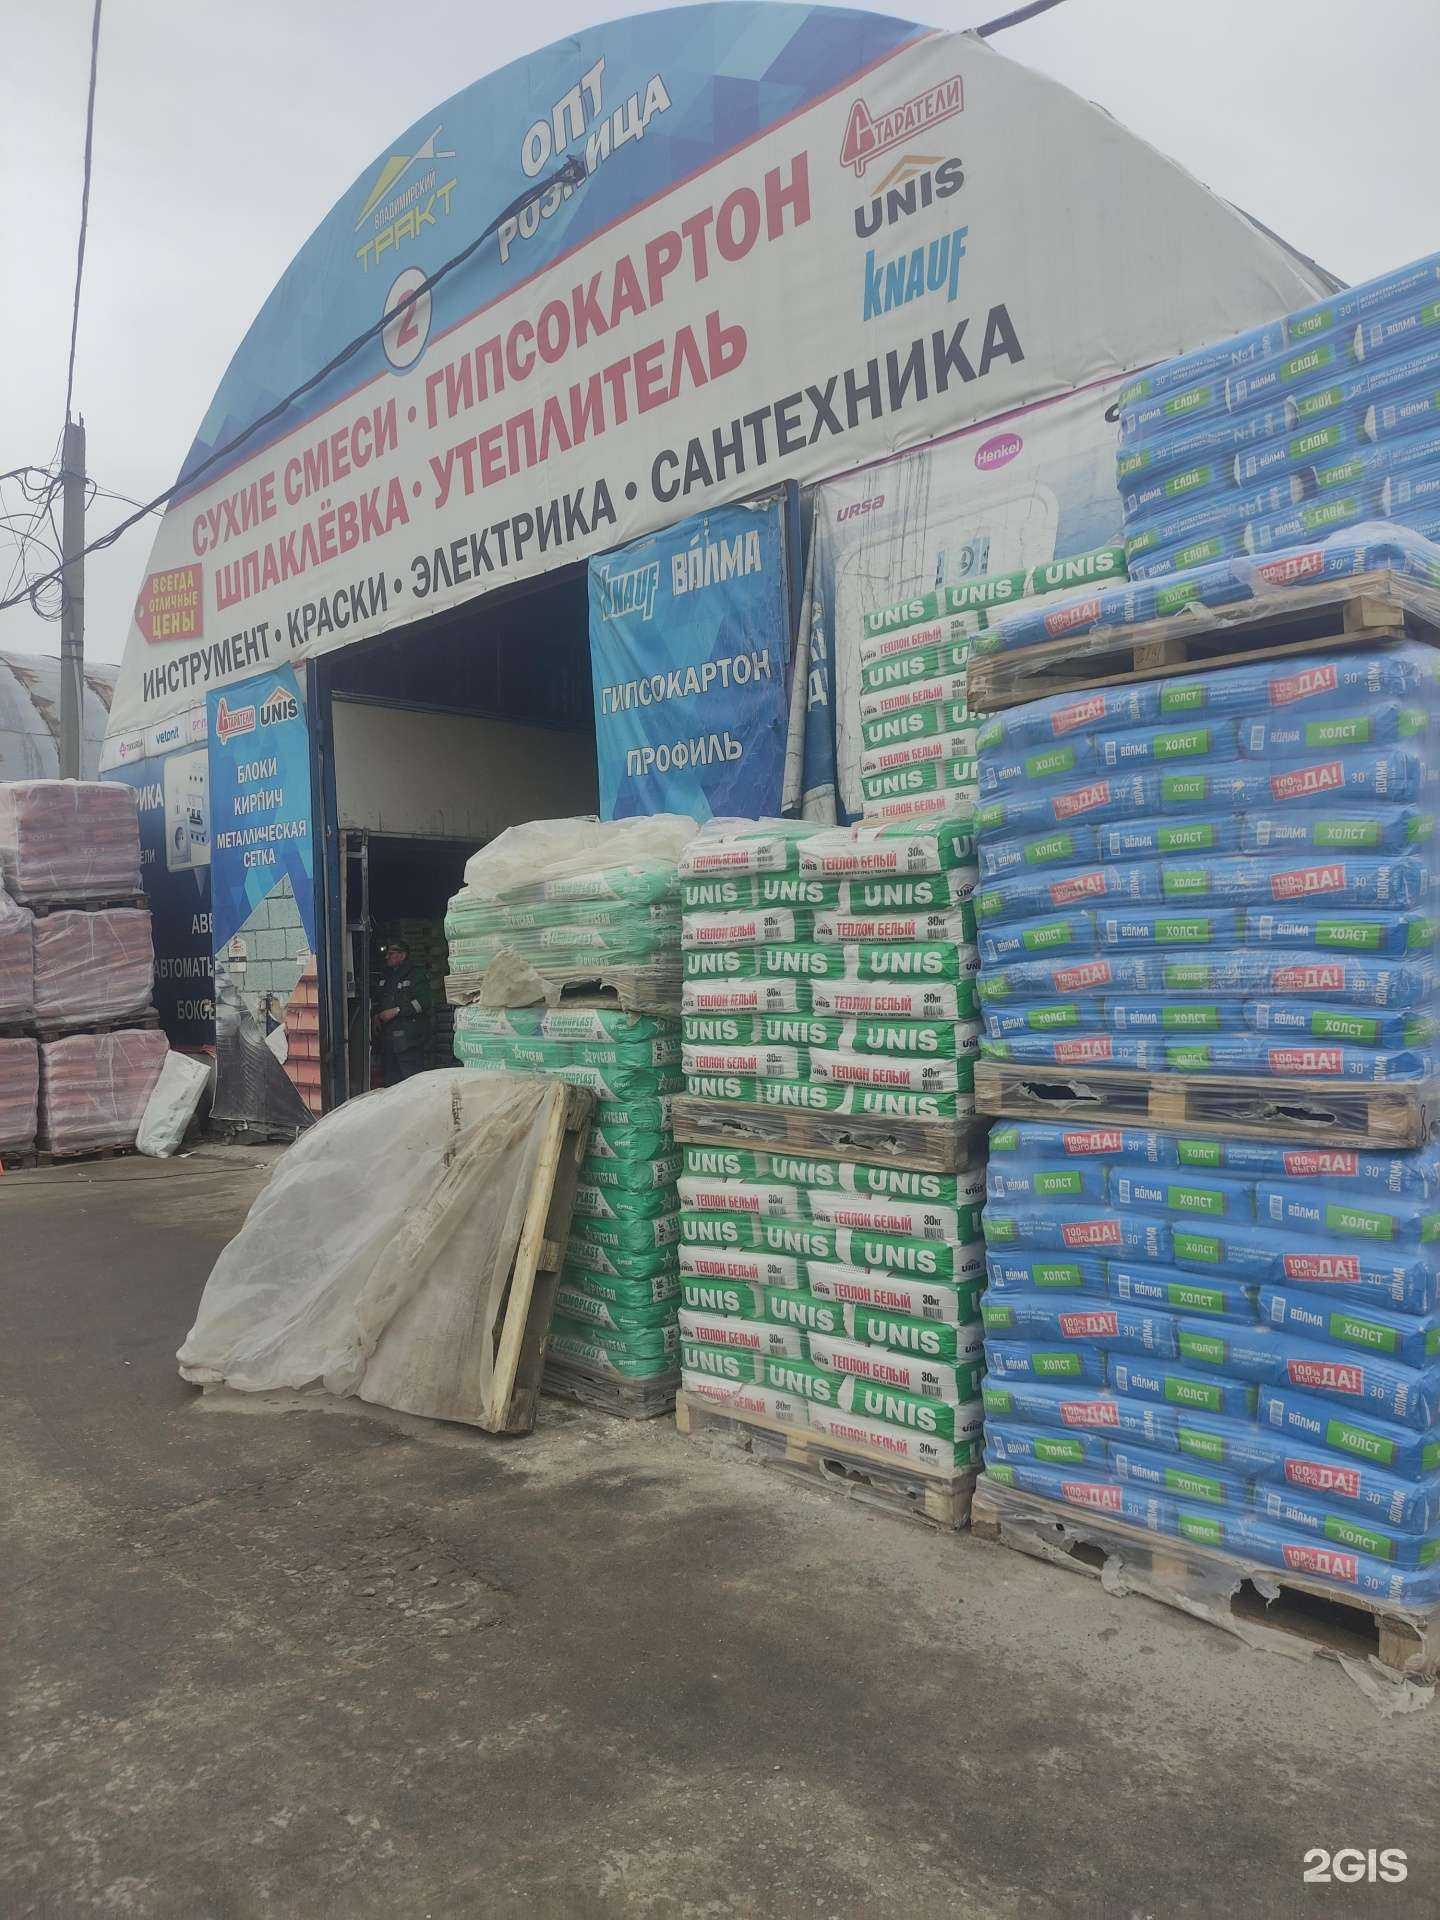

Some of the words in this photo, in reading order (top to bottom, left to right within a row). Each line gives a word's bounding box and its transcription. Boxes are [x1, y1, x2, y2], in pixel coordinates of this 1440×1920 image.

[521, 56, 606, 178] ОПТ
[497, 73, 672, 264] РОЗИЦА
[373, 166, 438, 231] ВЛАДИМИРСКИЙ
[854, 157, 965, 239] UNIS
[356, 178, 457, 273] ТРАКТ
[396, 288, 420, 349] 2
[192, 471, 277, 557] СУХИЕ
[283, 398, 398, 506] СМЕСИ
[425, 150, 812, 430] ГИПСОКАРТОН
[215, 476, 410, 612] ШПАКЛЁВКА
[429, 310, 748, 509] УТЕПЛИТЕЛЬ
[976, 437, 1021, 467] Henkel
[143, 622, 270, 703] ИНСТРУМЕНТ
[287, 571, 388, 649] КРАСКИ
[410, 478, 618, 598] ЭЛЕКТРИКА
[651, 304, 1026, 502] САНТЕХНИКА
[1045, 551, 1114, 585] UNIS
[152, 571, 195, 594] ВСЕГДА
[952, 578, 1012, 607] UNIS
[149, 591, 199, 612] ОТЛИЧНЫЕ
[869, 600, 924, 631] UNIS
[152, 611, 196, 640] ЦЕНЫ
[601, 649, 771, 715] ГИПСОКАРТОН
[868, 656, 926, 687] UNIS
[260, 698, 298, 726] UNIS
[868, 713, 924, 743] UNIS
[627, 732, 743, 777] ПРОФИЛЬ
[236, 757, 278, 784] БЛОКИ
[868, 769, 924, 798] UNIS
[234, 788, 283, 816] КИРПИЧ
[216, 820, 307, 849] МЕТАЛЛИЧЕСКАЯ
[243, 847, 276, 868] СЕТКА
[686, 882, 738, 906] UNIS
[764, 880, 824, 903] UNIS
[864, 882, 934, 908] UNIS
[836, 922, 875, 937] ТЕПЛОН
[877, 919, 916, 936] БЕЛЫЙ
[687, 951, 740, 975] UNIS
[766, 951, 828, 974] UNIS
[870, 951, 944, 974] UNIS
[834, 995, 873, 1011] ТЕПЛОН
[875, 993, 913, 1012] БЕЛЫЙ
[685, 1020, 739, 1041] UNIS
[766, 1020, 827, 1045] UNIS
[866, 1025, 938, 1052] UNIS
[687, 1076, 742, 1098] UNIS
[831, 1064, 870, 1081] ТЕПЛОН
[872, 1065, 911, 1085] БЕЛЫЙ
[765, 1083, 828, 1108] UNIS
[863, 1093, 939, 1119] UNIS
[688, 1152, 741, 1175] UNIS
[772, 1158, 834, 1186] UNIS
[868, 1169, 941, 1197] UNIS
[729, 1193, 759, 1211] БЕЛЫЙ
[683, 1221, 738, 1242] UNIS
[833, 1211, 871, 1228] ТЕПЛОН
[873, 1212, 913, 1231] БЕЛЫЙ
[1340, 1214, 1380, 1231] ХОЛСТ
[767, 1226, 829, 1258] UNIS
[694, 1260, 726, 1276] ТЕПЛОН
[728, 1261, 758, 1279] БЕЛЫЙ
[864, 1242, 936, 1274] UNIS
[684, 1287, 740, 1312] UNIS
[833, 1282, 871, 1302] ТЕПЛОН
[873, 1289, 912, 1309] БЕЛЫЙ
[771, 1297, 834, 1332] UNIS
[696, 1326, 727, 1343] ТЕПЛОН
[728, 1330, 761, 1349] БЕЛЫЙ
[867, 1318, 941, 1355] UNIS
[1344, 1323, 1383, 1343] ХОЛСТ
[684, 1349, 740, 1377] UNIS
[832, 1354, 870, 1375] ТЕПЛОН
[873, 1364, 911, 1386] БЕЛЫЙ
[769, 1364, 831, 1401] UNIS
[1321, 1367, 1357, 1389] ДА!
[865, 1390, 937, 1432] UNIS
[1342, 1431, 1381, 1454] ХОЛСТ
